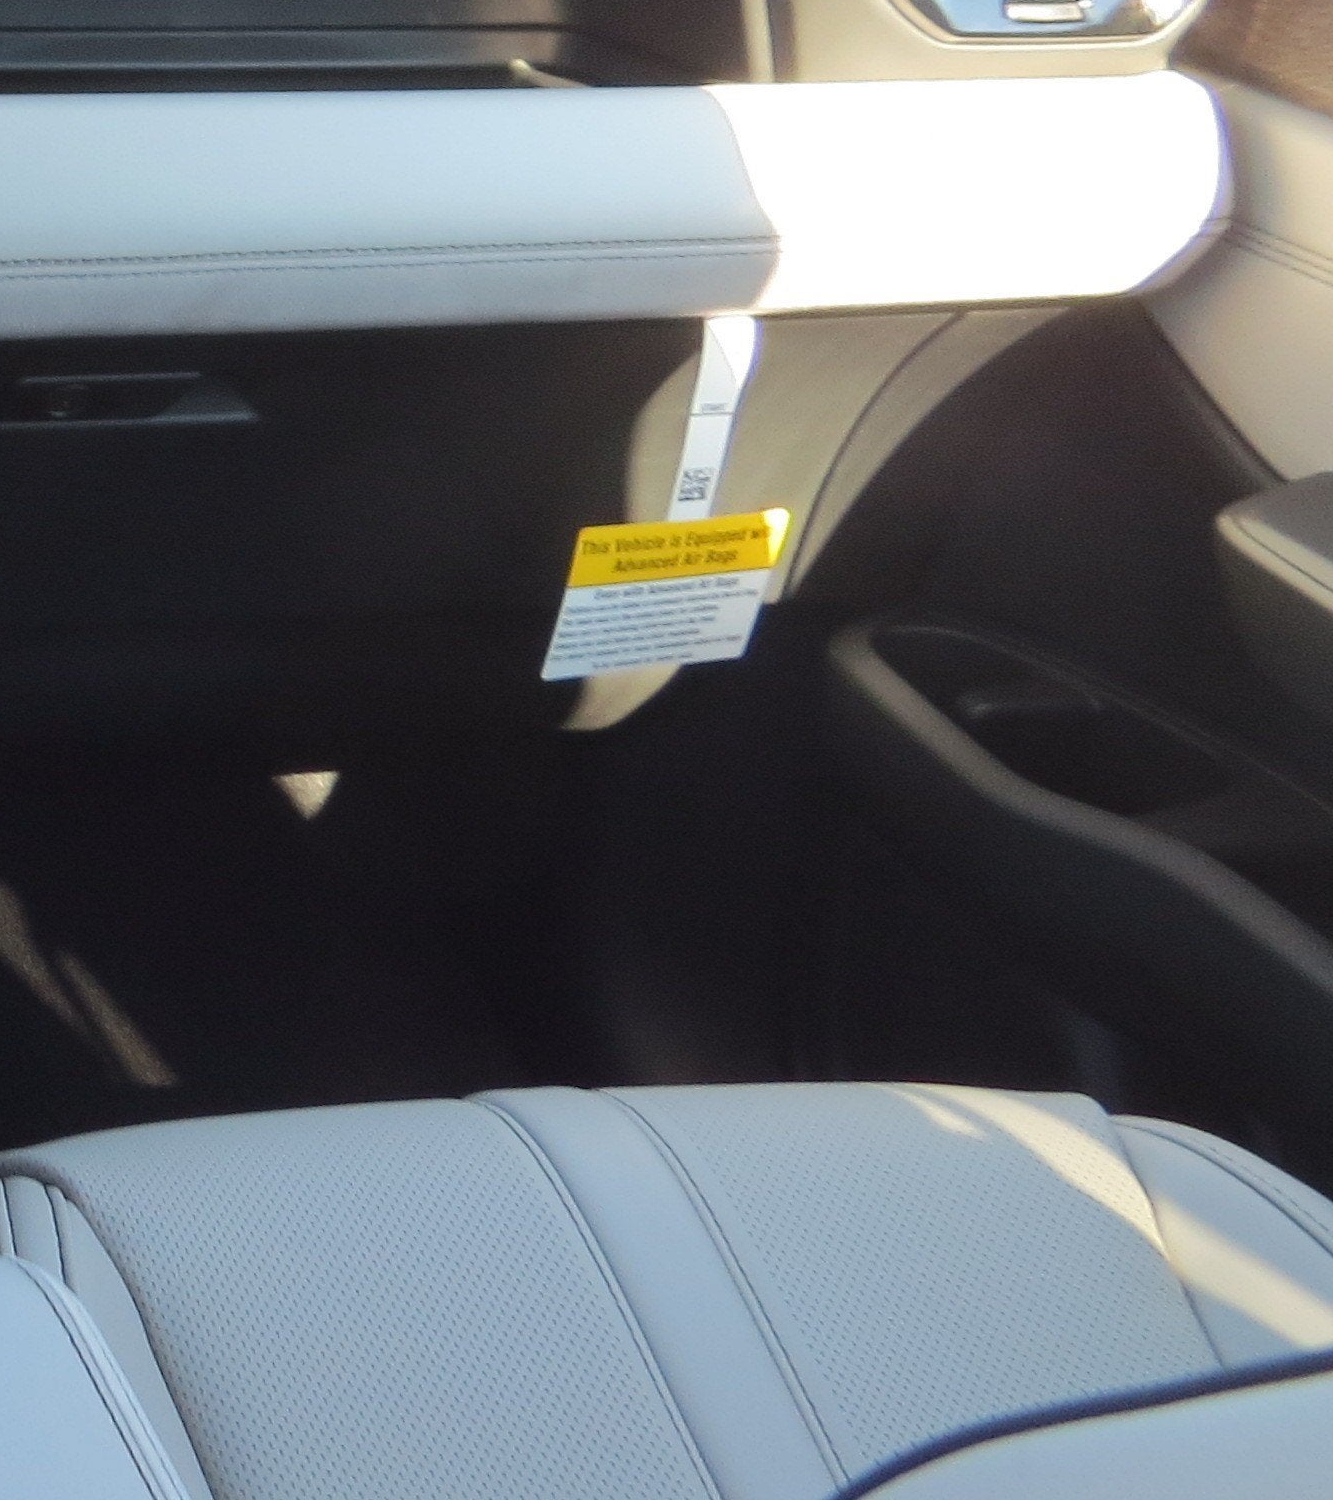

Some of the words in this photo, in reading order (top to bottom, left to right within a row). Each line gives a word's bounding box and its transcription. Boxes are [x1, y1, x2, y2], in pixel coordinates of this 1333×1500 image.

[583, 539, 611, 554] This
[615, 533, 667, 552] Vehicle
[669, 534, 683, 547] is
[685, 527, 747, 547] Equipped
[614, 556, 679, 573] Advanced
[681, 552, 704, 565] Air
[707, 549, 738, 563] Bags
